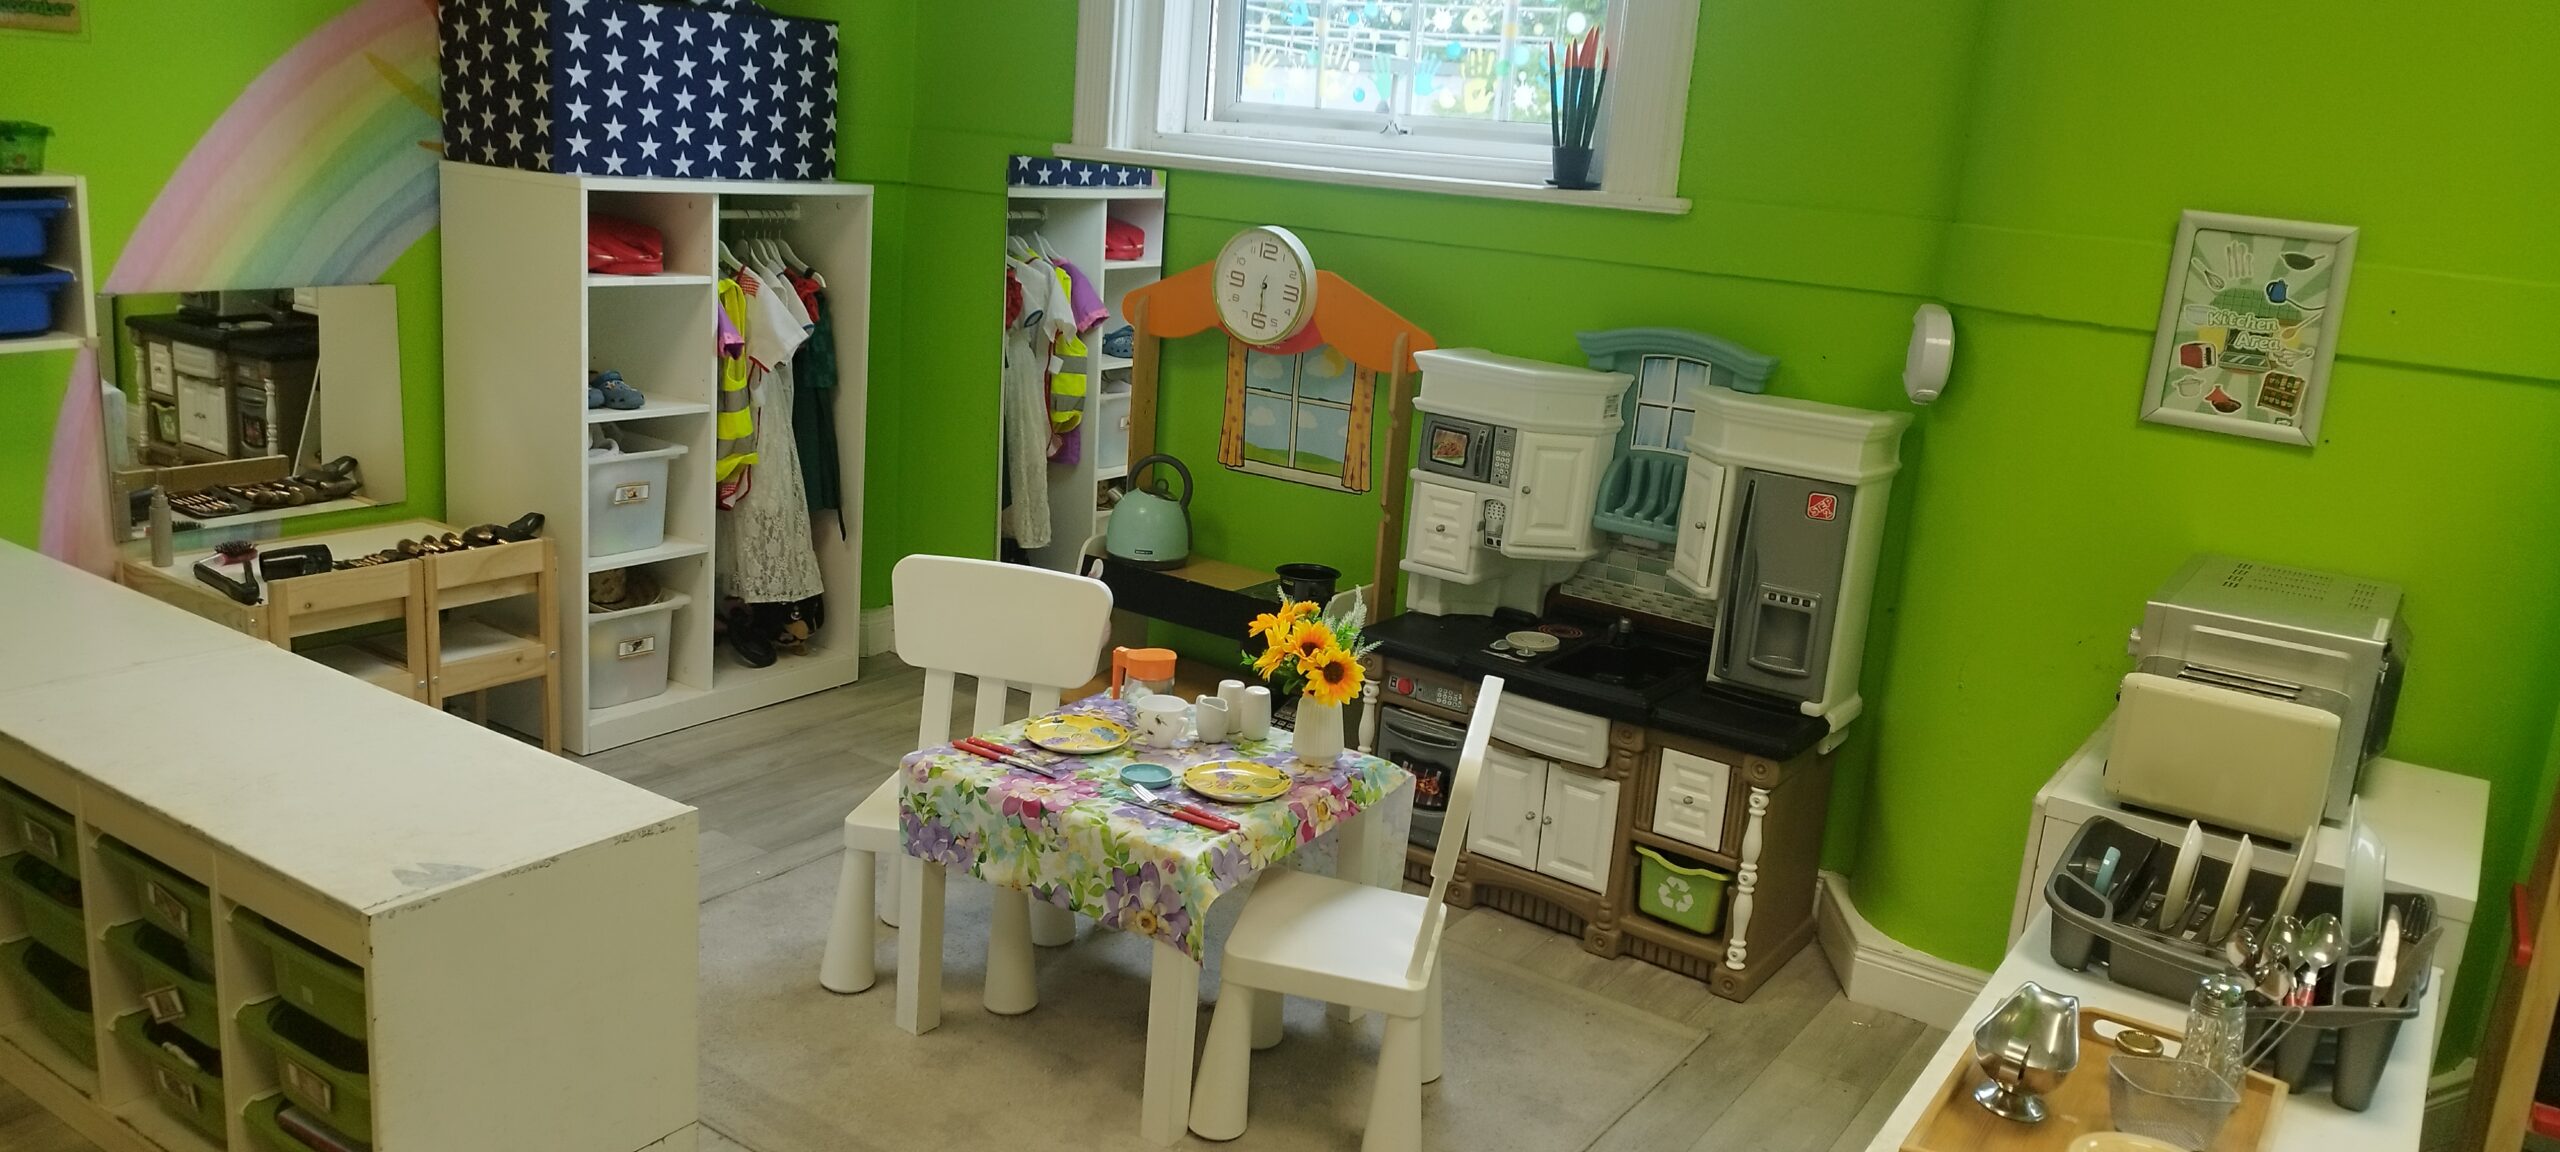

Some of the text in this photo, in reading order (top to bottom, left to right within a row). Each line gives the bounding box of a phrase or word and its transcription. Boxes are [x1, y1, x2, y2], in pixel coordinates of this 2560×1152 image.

[1250, 246, 1256, 255] 11
[1259, 241, 1279, 262] 12
[1236, 256, 1246, 266] 10
[1229, 270, 1246, 288] 9
[1289, 270, 1297, 280] 2
[1232, 293, 1240, 302] 8
[1282, 284, 1300, 303] 3
[1241, 309, 1249, 319] 7
[1284, 308, 1291, 317] 4
[1251, 311, 1268, 330] 6
[1270, 318, 1278, 328] 5
[2208, 310, 2279, 331] Kitchen
[2234, 332, 2280, 350] Area
[1810, 497, 1832, 516] STEP
